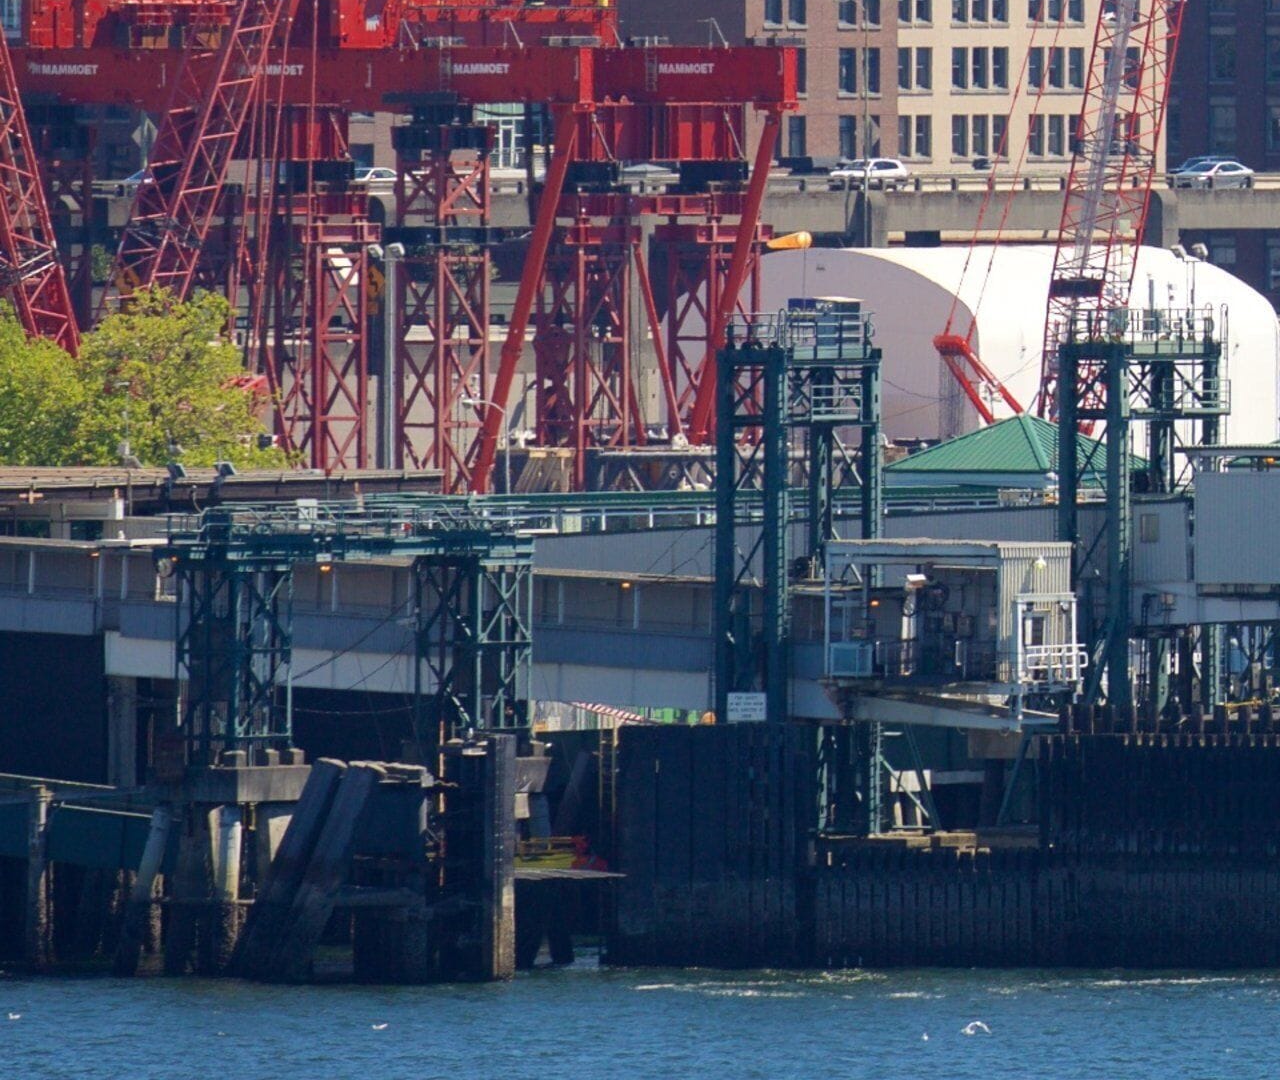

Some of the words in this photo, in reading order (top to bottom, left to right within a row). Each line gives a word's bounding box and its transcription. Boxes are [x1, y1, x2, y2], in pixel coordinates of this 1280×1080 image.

[42, 64, 99, 75] MAMMOET
[453, 63, 510, 75] MAMMOET
[658, 63, 715, 75] MAMMOET
